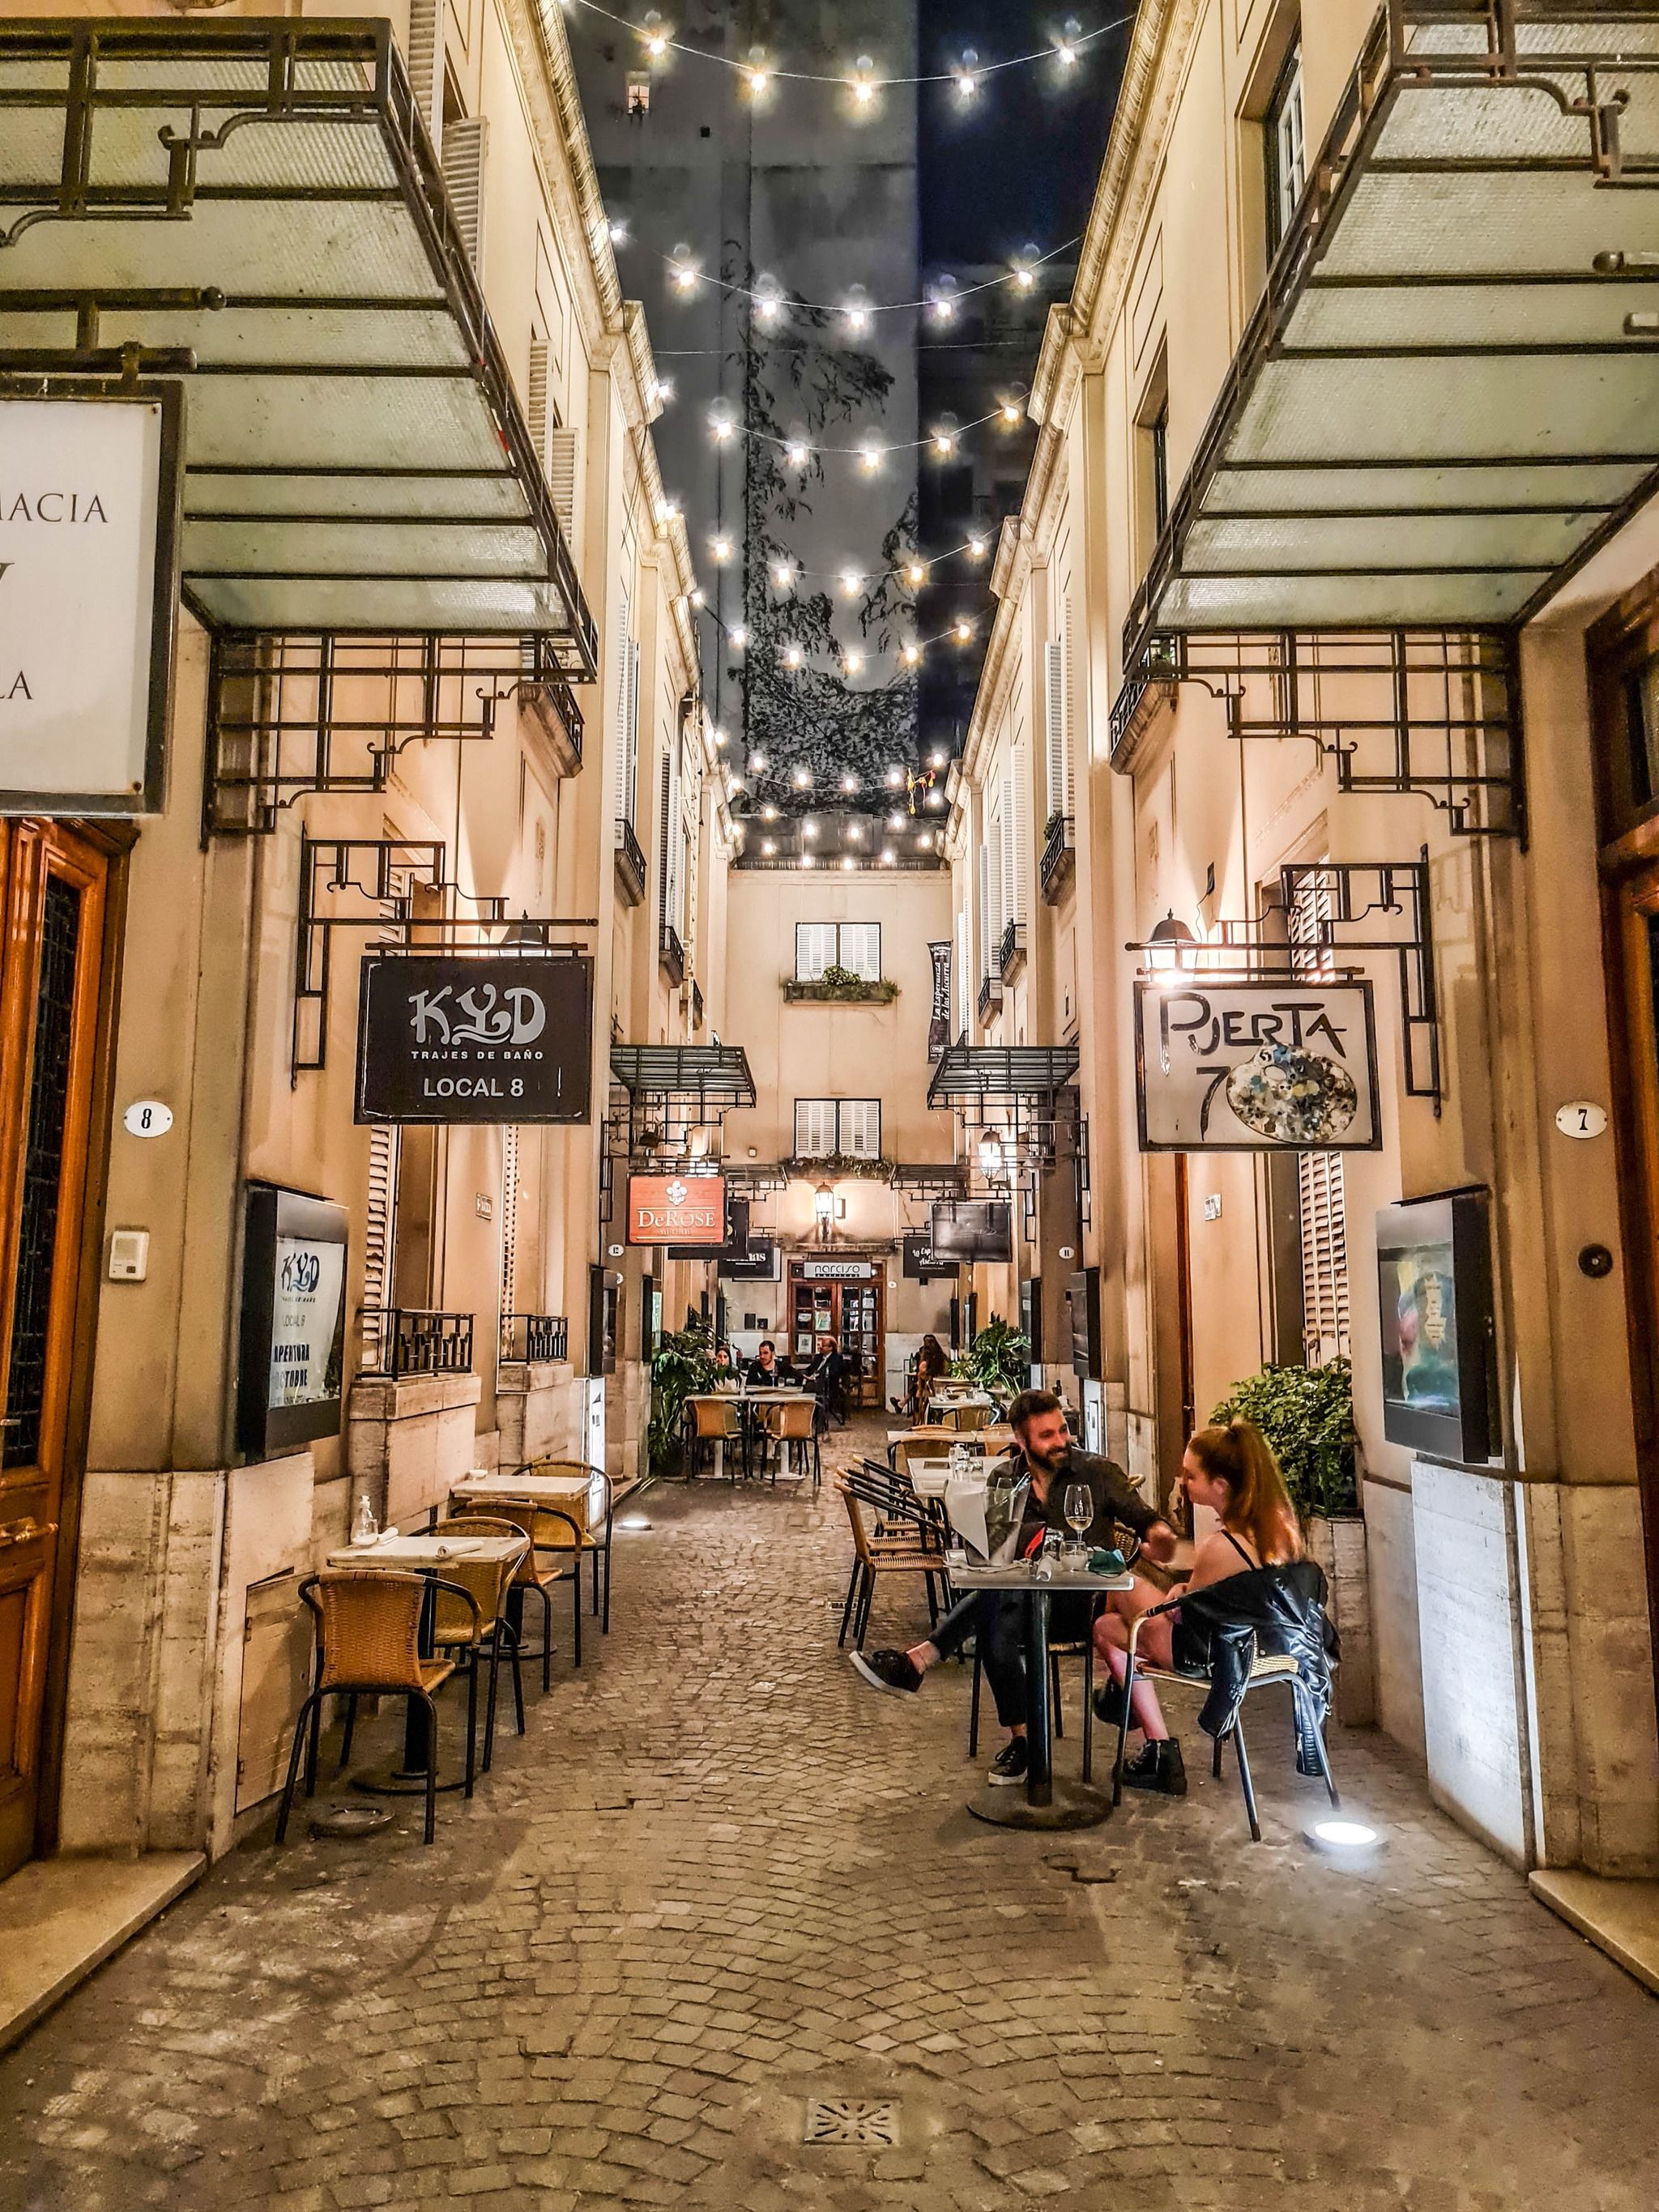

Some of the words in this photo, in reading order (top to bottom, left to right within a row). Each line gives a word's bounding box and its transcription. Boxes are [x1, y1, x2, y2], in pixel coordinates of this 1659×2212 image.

[0, 492, 109, 523] ACIA
[408, 983, 546, 1046] KYD
[932, 1008, 940, 1021] La
[941, 1009, 949, 1020] de
[411, 1051, 468, 1060] TRAJES
[476, 1051, 495, 1060] DE
[503, 1049, 544, 1060] BAÑO
[424, 1077, 504, 1097] LOCAL
[510, 1077, 524, 1097] 8
[1196, 1066, 1231, 1142] 7
[141, 1108, 152, 1129] 8
[1578, 1109, 1589, 1131] 7
[281, 1252, 320, 1293] KYD
[815, 1265, 860, 1273] narciso
[274, 1344, 310, 1362] APERTURA
